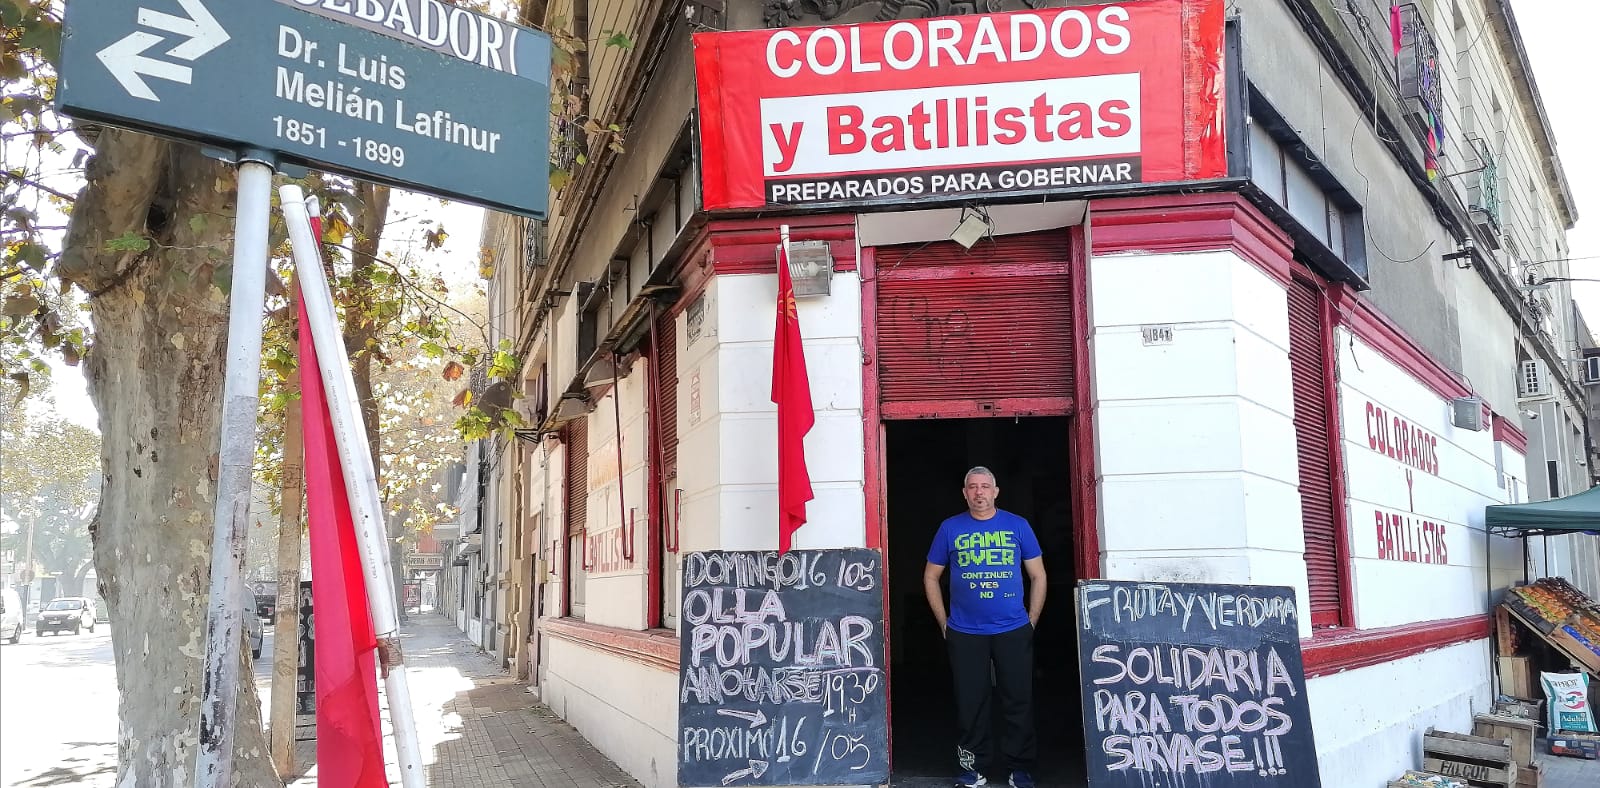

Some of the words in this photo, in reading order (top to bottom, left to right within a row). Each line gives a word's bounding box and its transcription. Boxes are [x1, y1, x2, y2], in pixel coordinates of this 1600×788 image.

[278, 24, 325, 68] Dr.
[338, 42, 406, 90] Luis
[765, 6, 1131, 79] COLORADOS
[275, 67, 384, 125] Melián
[396, 99, 500, 153] Lafinur
[769, 120, 803, 172] y
[826, 92, 1132, 156] Batllistas
[273, 115, 327, 149] 1851
[353, 137, 405, 168] 1899
[772, 177, 924, 203] PREPARADOS
[930, 171, 992, 191] PARA
[998, 163, 1132, 188] GOBERNAR
[1366, 400, 1439, 476] COLORADOS
[1405, 468, 1413, 512] Y
[954, 530, 1016, 550] GAME
[957, 548, 1014, 567] OVER
[794, 552, 826, 590] 16
[961, 571, 1013, 579] CONTINUE?
[980, 591, 994, 599] NO
[683, 588, 786, 626] OLLA
[1081, 584, 1178, 630] FRUTA
[1174, 591, 1196, 632] Y
[1198, 591, 1298, 630] VERDURA
[691, 615, 874, 668] POPULAR
[1091, 644, 1297, 697] SOLIDARIA
[1094, 689, 1171, 734] PARA
[1170, 693, 1293, 736] TODOS
[776, 715, 807, 763] 16
